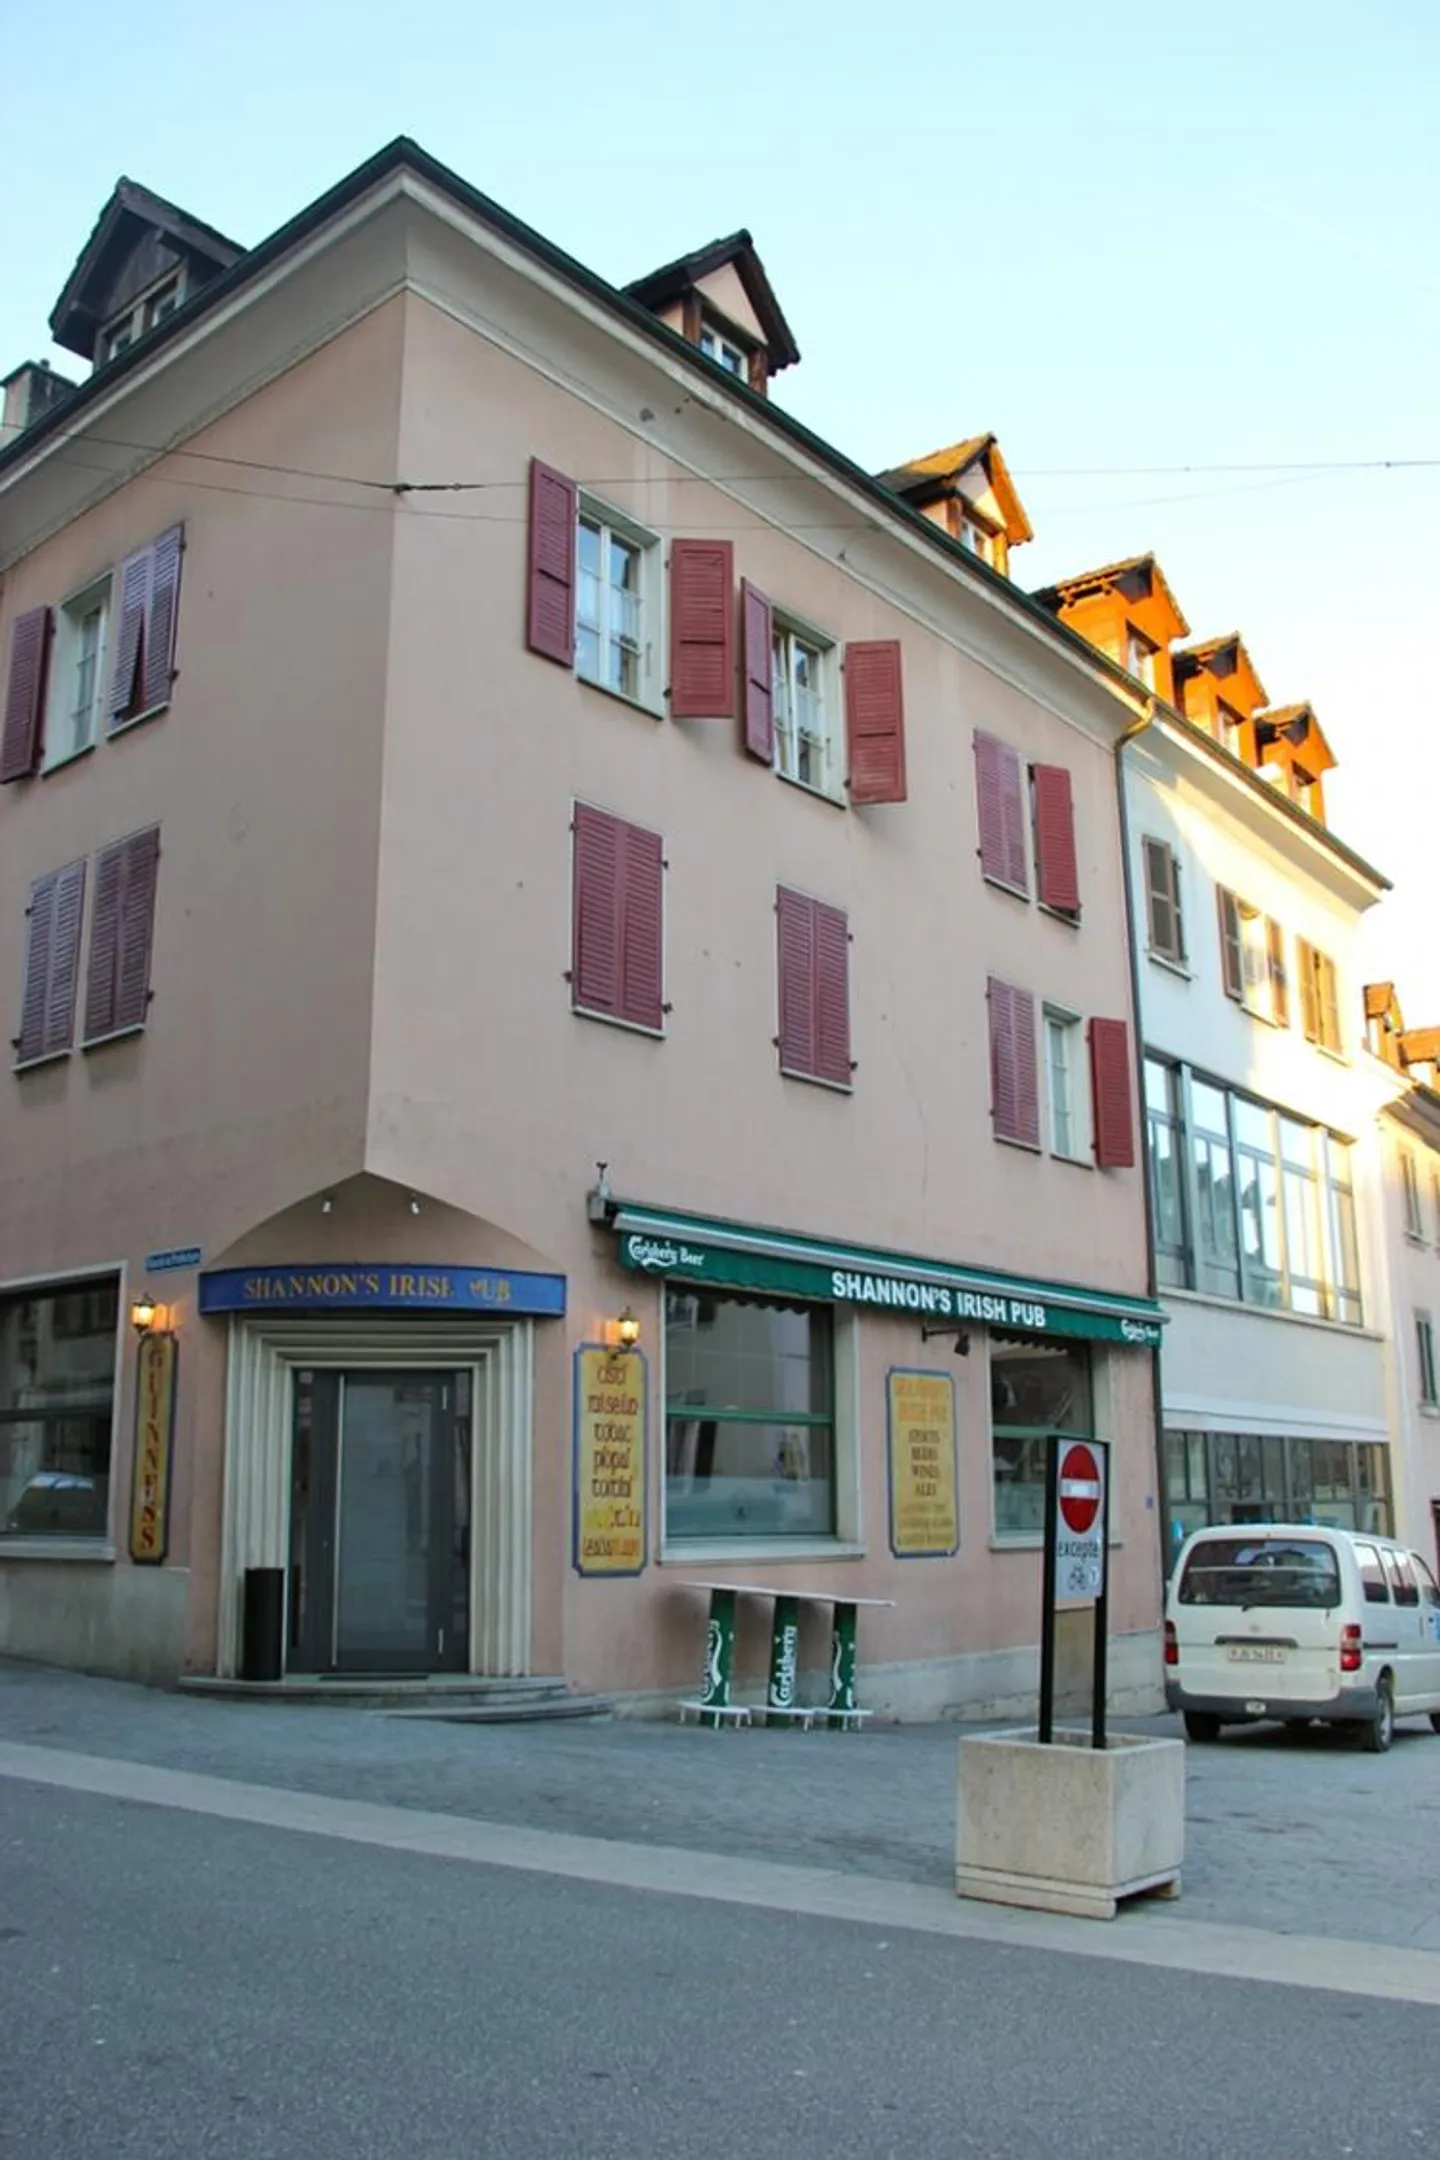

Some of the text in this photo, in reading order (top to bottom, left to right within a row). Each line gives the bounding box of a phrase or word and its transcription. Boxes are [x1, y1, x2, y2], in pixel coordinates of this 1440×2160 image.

[243, 1272, 380, 1300] SHANNON'S
[831, 1270, 1046, 1328] SHANNON'S IRISH PUB
[770, 1624, 798, 1707] Carlsberg
